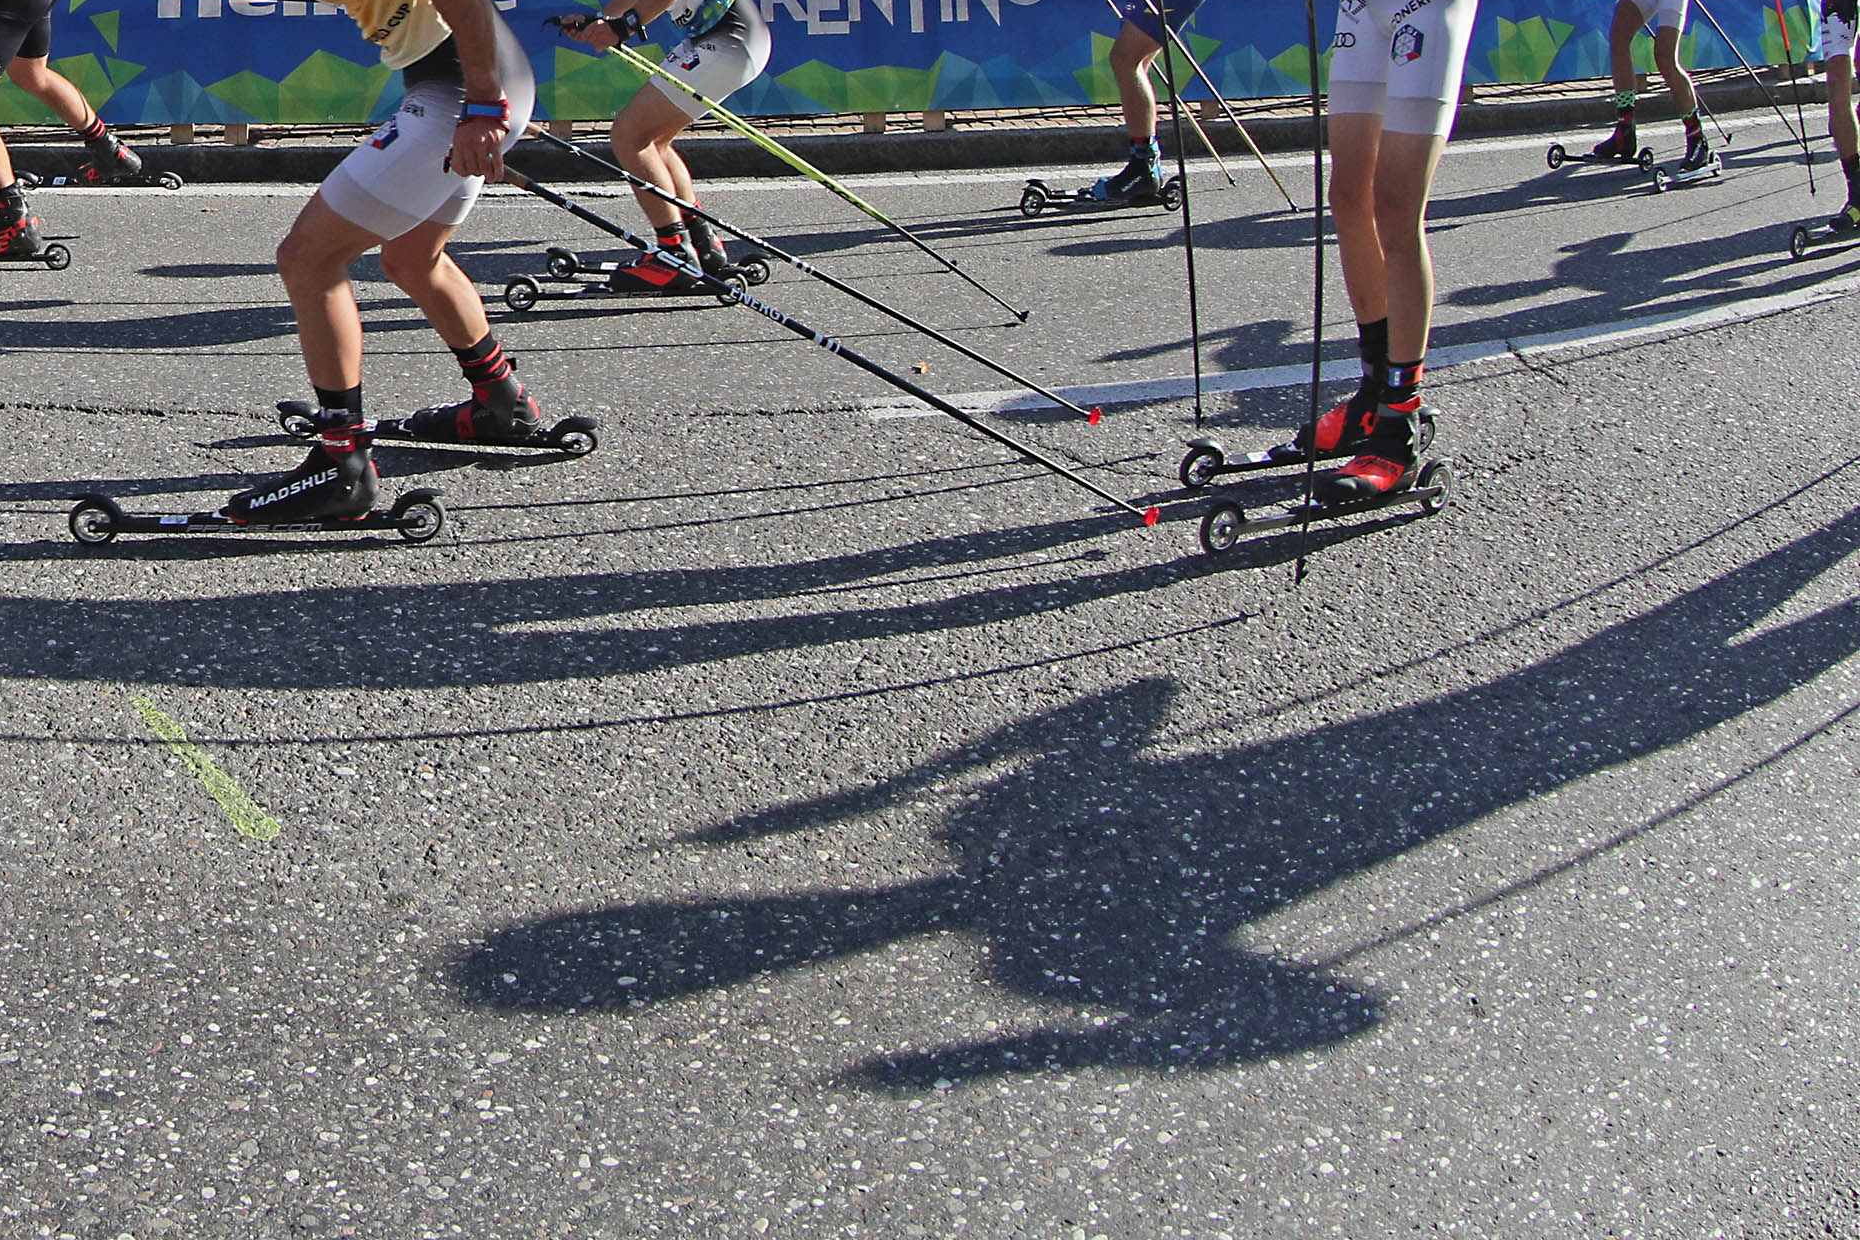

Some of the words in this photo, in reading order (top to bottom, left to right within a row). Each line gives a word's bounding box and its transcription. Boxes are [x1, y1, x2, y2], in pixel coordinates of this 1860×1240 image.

[387, 2, 411, 28] CUP
[729, 286, 791, 325] ENERGY
[249, 467, 340, 510] MADSHUS
